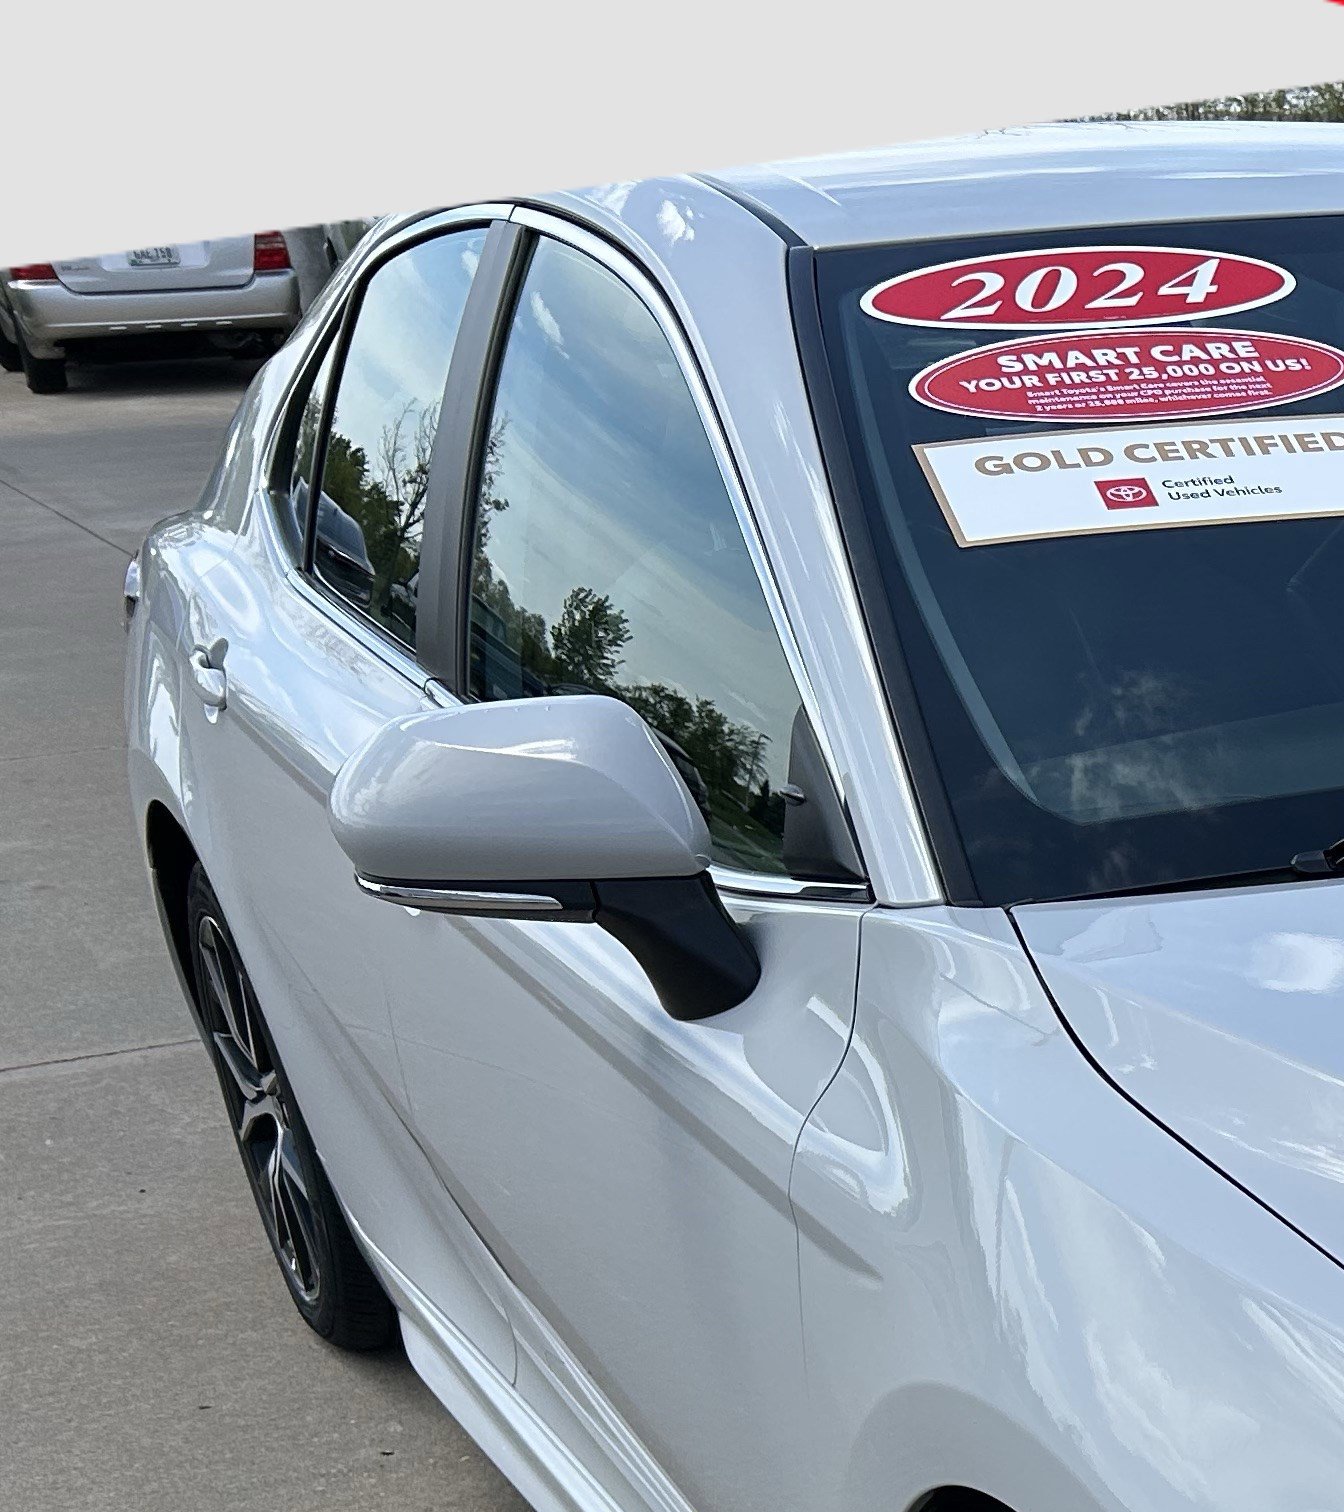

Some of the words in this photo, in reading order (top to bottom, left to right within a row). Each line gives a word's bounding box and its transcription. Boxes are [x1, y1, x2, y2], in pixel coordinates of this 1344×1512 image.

[940, 258, 1220, 320] 2024
[996, 345, 1142, 373] SMART
[1150, 341, 1260, 362] CARE
[958, 374, 1044, 394] YOUR
[1044, 368, 1120, 386] FIRST
[1124, 363, 1216, 381] 25,000
[1219, 360, 1264, 374] ON
[1264, 357, 1312, 371] US!
[974, 446, 1114, 477] GOLD
[1161, 475, 1235, 489] Certified
[1167, 490, 1211, 501] Used
[1212, 484, 1283, 498] Vehicles
